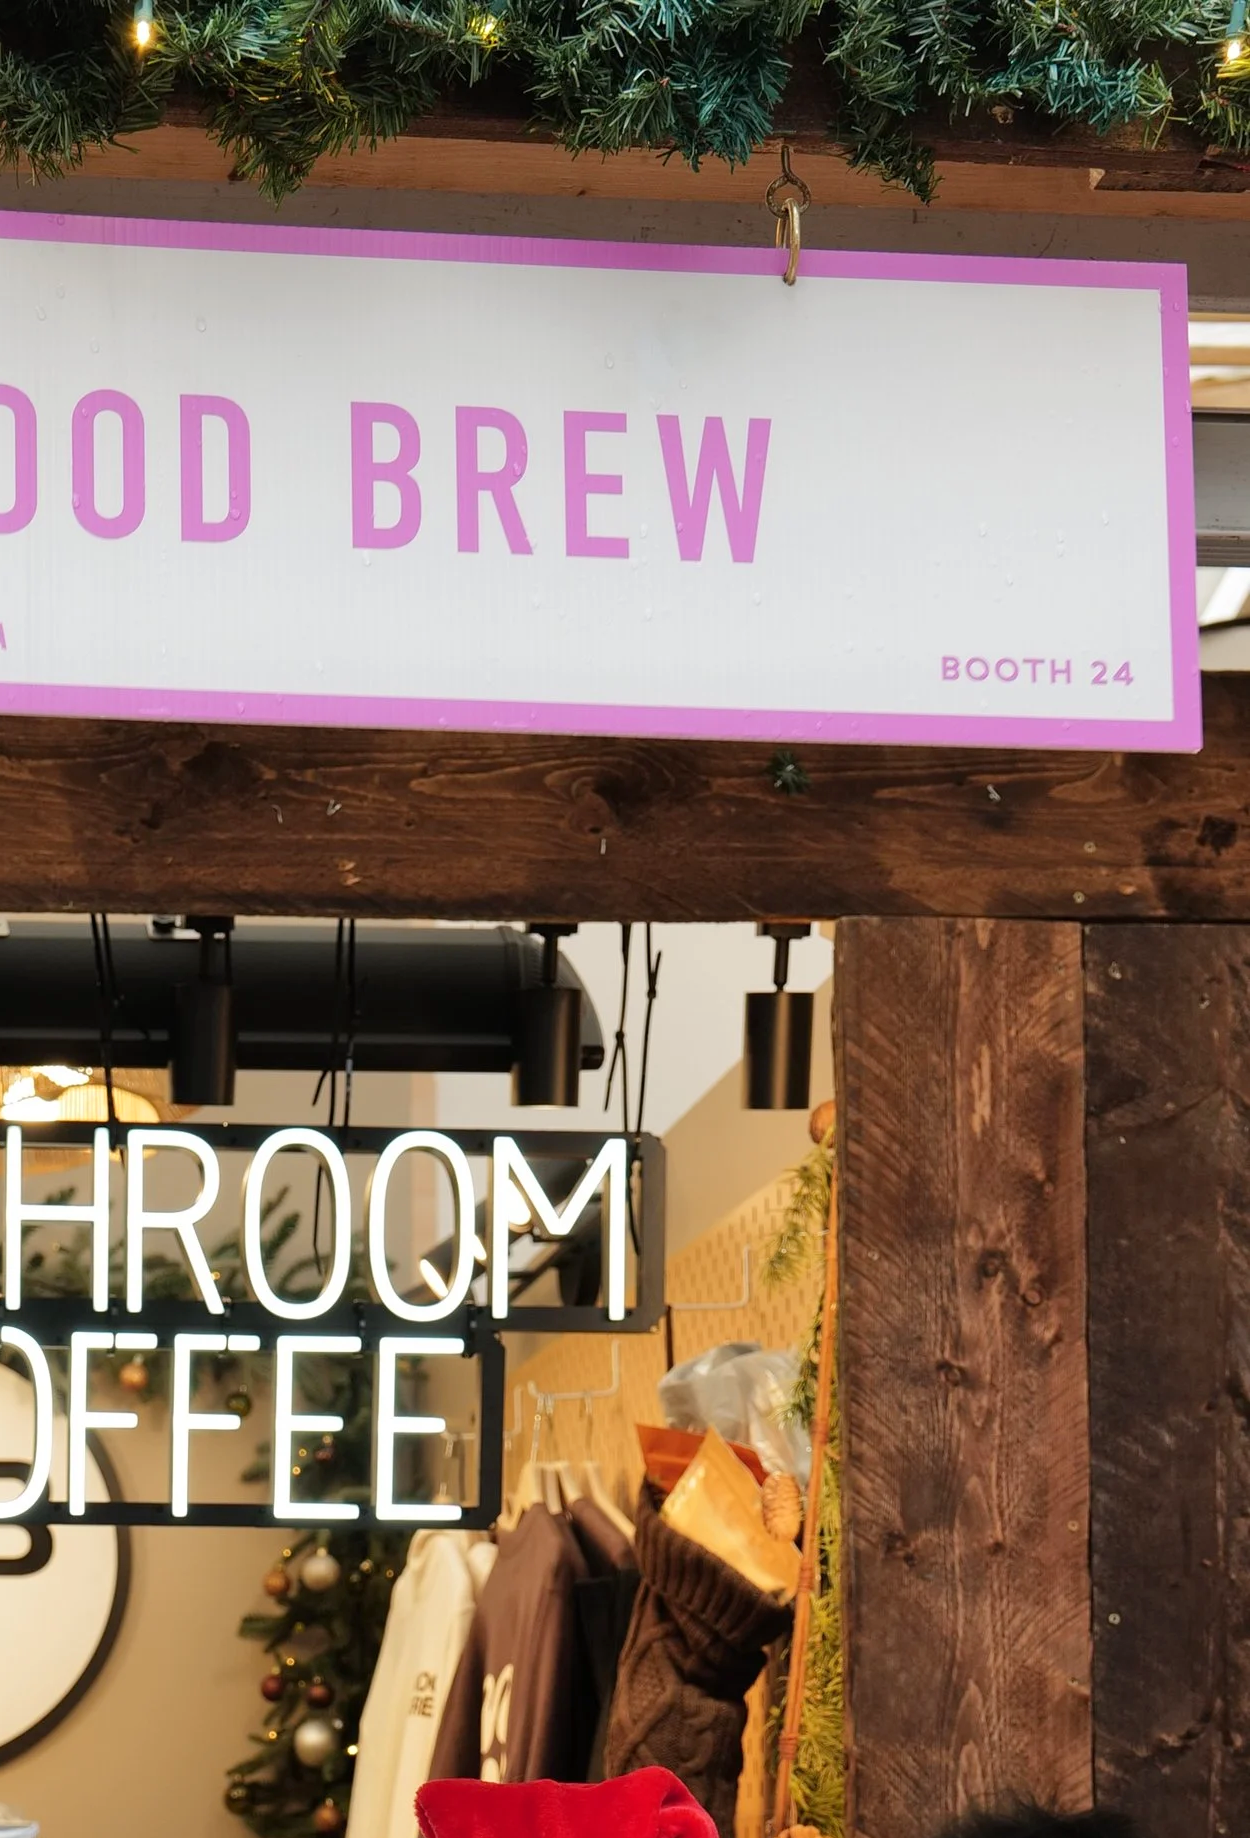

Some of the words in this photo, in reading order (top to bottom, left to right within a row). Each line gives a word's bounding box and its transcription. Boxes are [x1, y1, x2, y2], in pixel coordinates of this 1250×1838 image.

[350, 401, 772, 563] BREW
[941, 656, 1072, 685] BOOTH
[1090, 660, 1134, 686] 24
